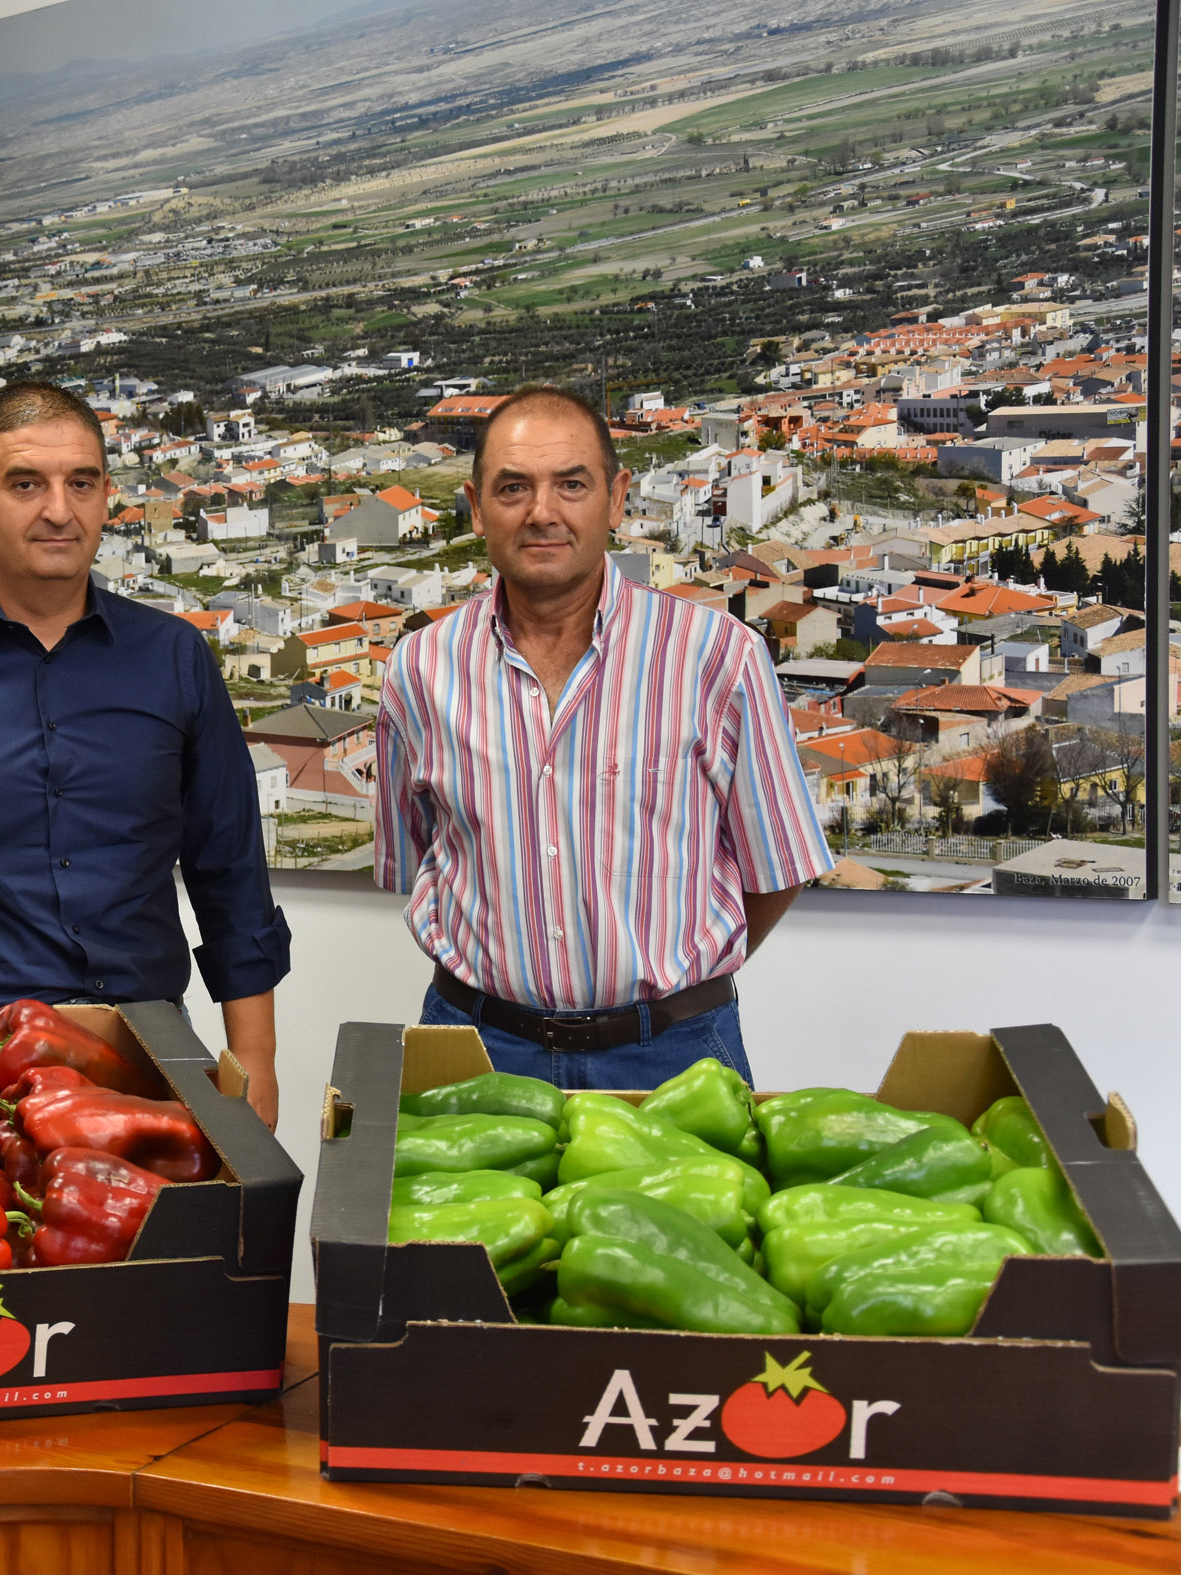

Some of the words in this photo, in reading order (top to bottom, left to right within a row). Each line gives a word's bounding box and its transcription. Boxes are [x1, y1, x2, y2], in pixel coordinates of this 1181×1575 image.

[1014, 873, 1046, 886] Baza,
[1050, 874, 1089, 886] Marzo
[1093, 875, 1108, 886] de
[1112, 876, 1141, 887] 2007
[577, 1461, 896, 1486] t.azorbaza@hotmail.com
